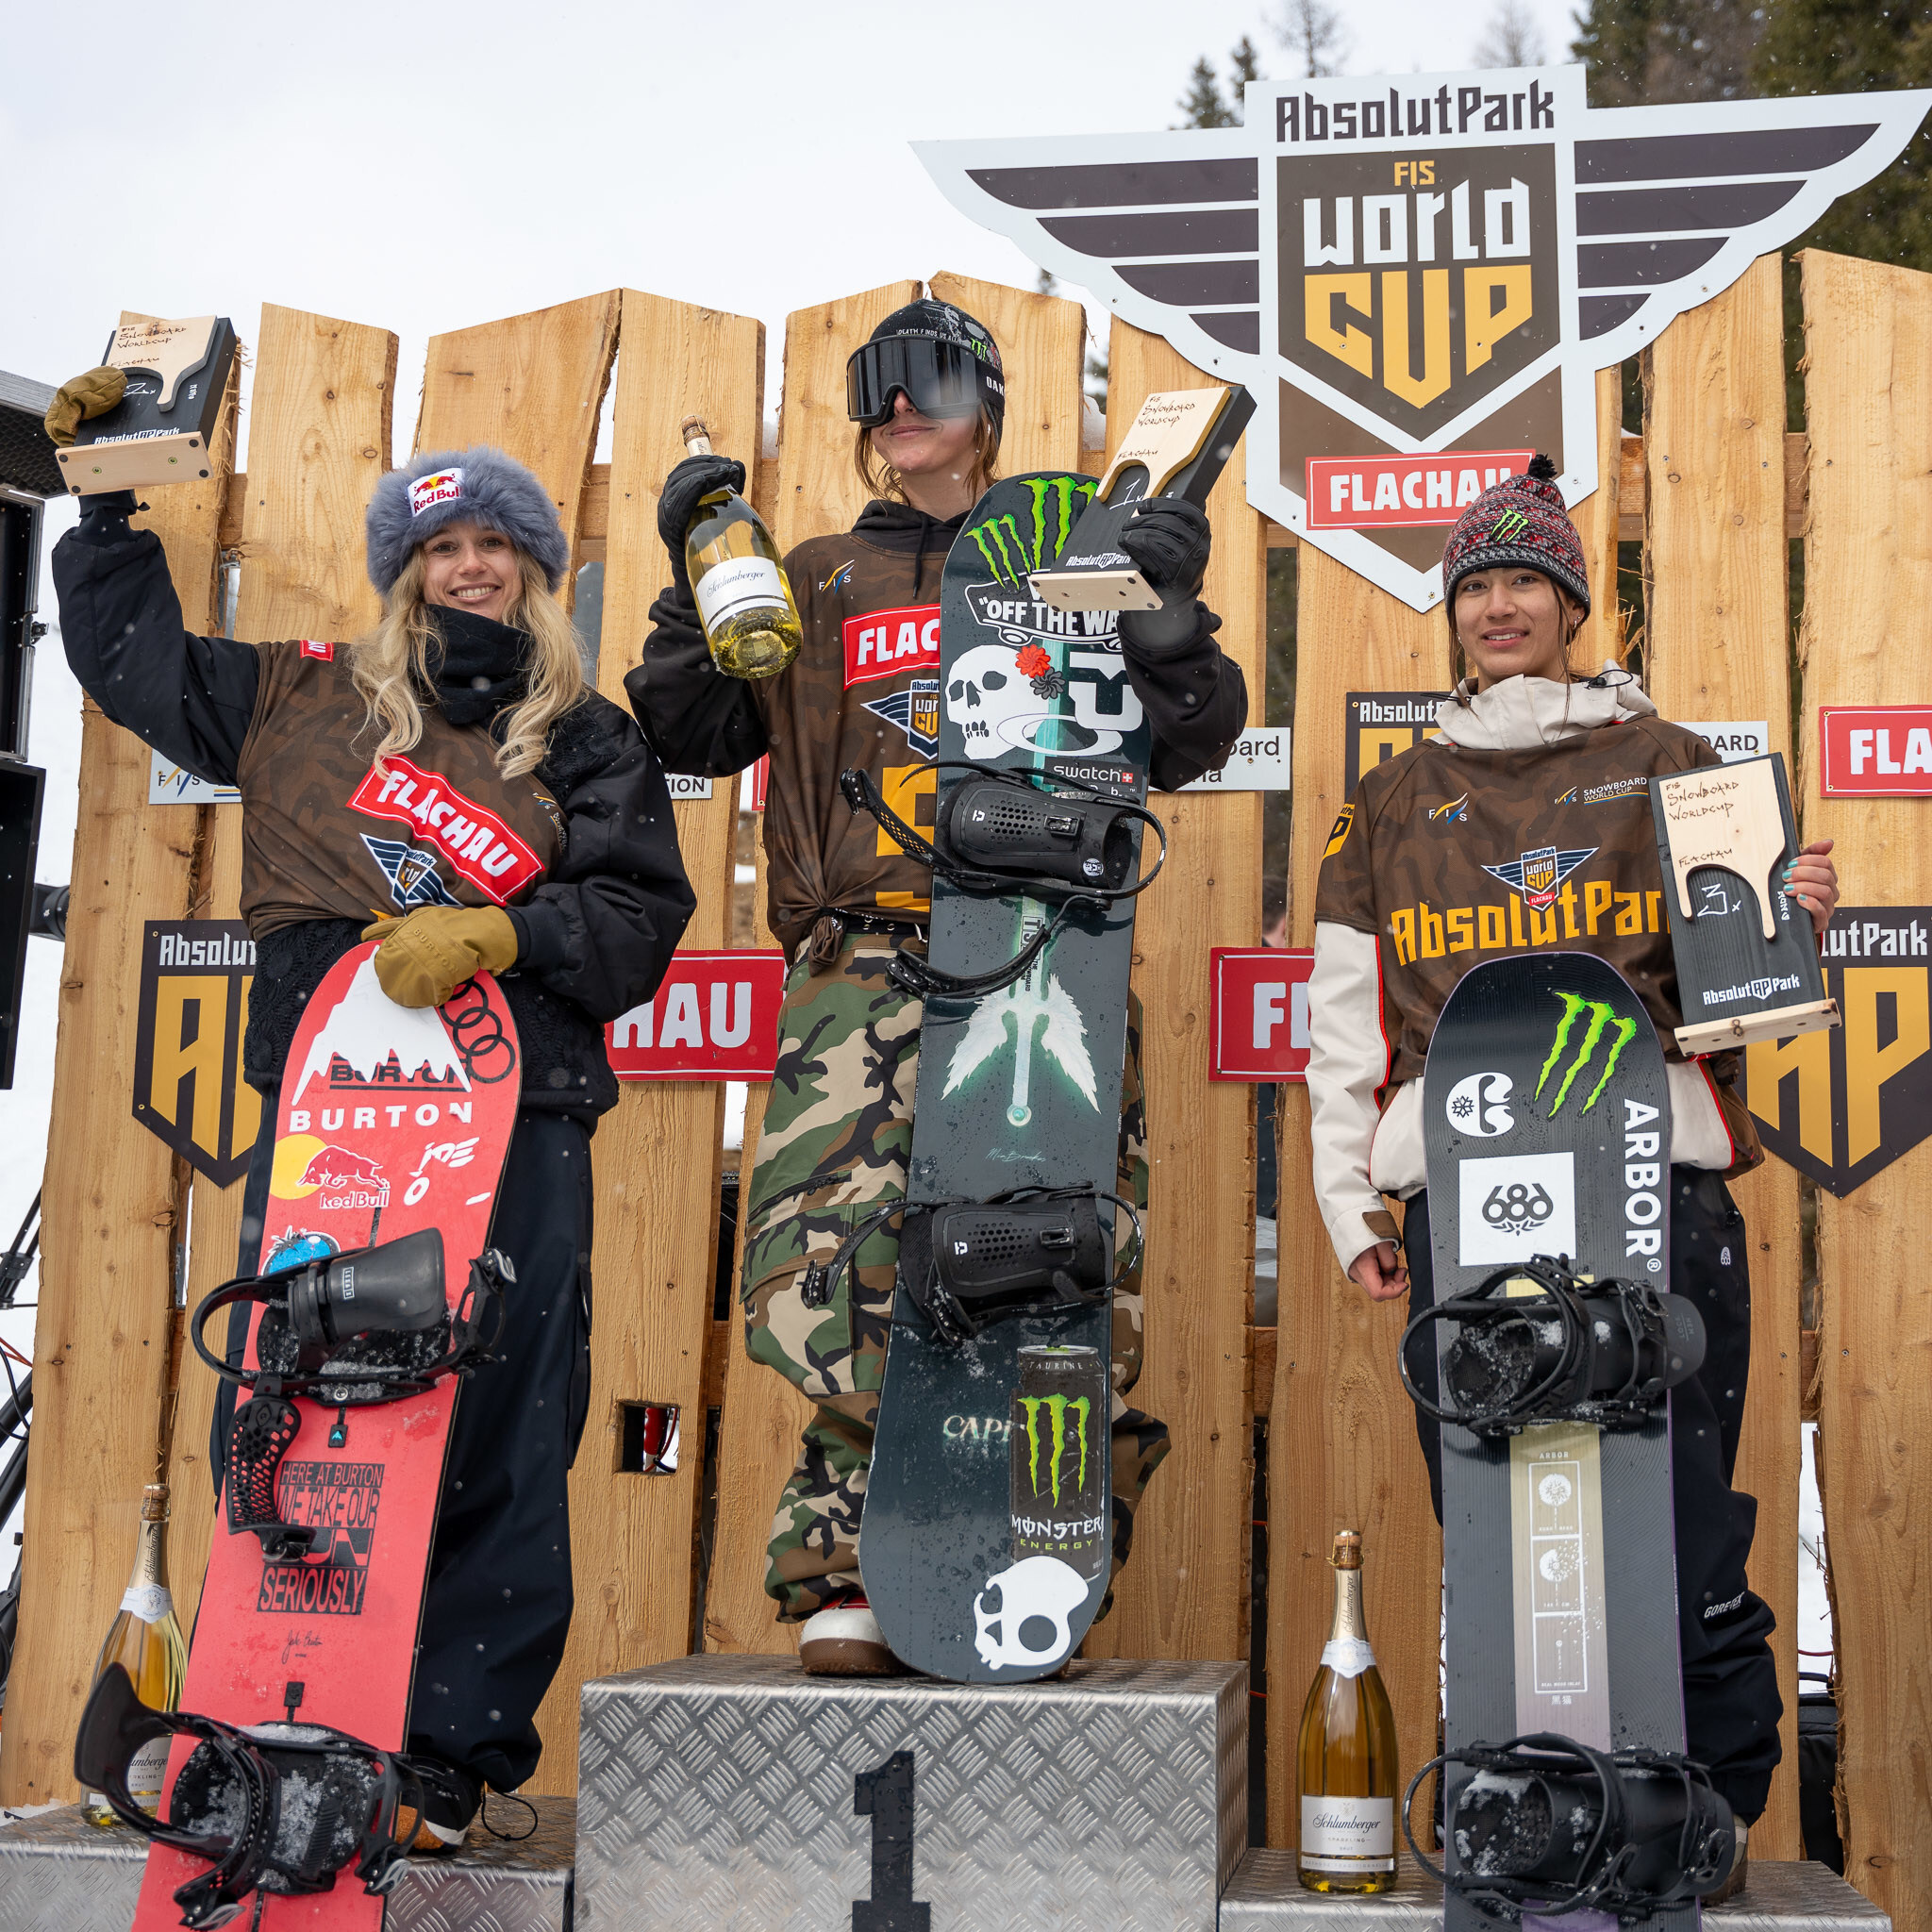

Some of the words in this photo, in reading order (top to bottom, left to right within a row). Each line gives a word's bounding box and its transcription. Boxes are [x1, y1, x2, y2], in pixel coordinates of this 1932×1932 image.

[1276, 79, 1555, 142] AbsolutPark
[1394, 160, 1435, 186] FIS
[1305, 264, 1533, 408] CUP
[412, 491, 436, 514] Red
[1330, 468, 1511, 512] FLACHA
[1053, 765, 1123, 782] swatch
[1584, 776, 1647, 796] SNOWBOARD
[1584, 791, 1614, 802] WORLD
[1616, 786, 1632, 795] CUP
[1665, 782, 1681, 791] FIS
[1667, 782, 1740, 807] SNOWBOARD
[376, 770, 519, 877] FLACHAU
[1428, 808, 1468, 823] FIS
[1526, 870, 1554, 890] CUP
[1391, 879, 1670, 967] AbsolutPar
[1703, 982, 1752, 1006] Absolut
[1772, 973, 1801, 991] Park
[289, 1101, 473, 1132] BURTON
[355, 1190, 390, 1207] Bull
[1482, 1182, 1554, 1224] 686
[1539, 1451, 1570, 1459] ARBOR
[282, 1463, 314, 1485] HERE
[315, 1465, 331, 1486] AT
[333, 1465, 382, 1488] BURTON
[306, 1487, 348, 1526] TAKE
[346, 1489, 380, 1527] OUR
[1020, 1538, 1093, 1550] ENERGY
[258, 1566, 367, 1612] SERIOUSLY
[1312, 1812, 1381, 1834] Schlumberger
[851, 1750, 931, 1932] 1
